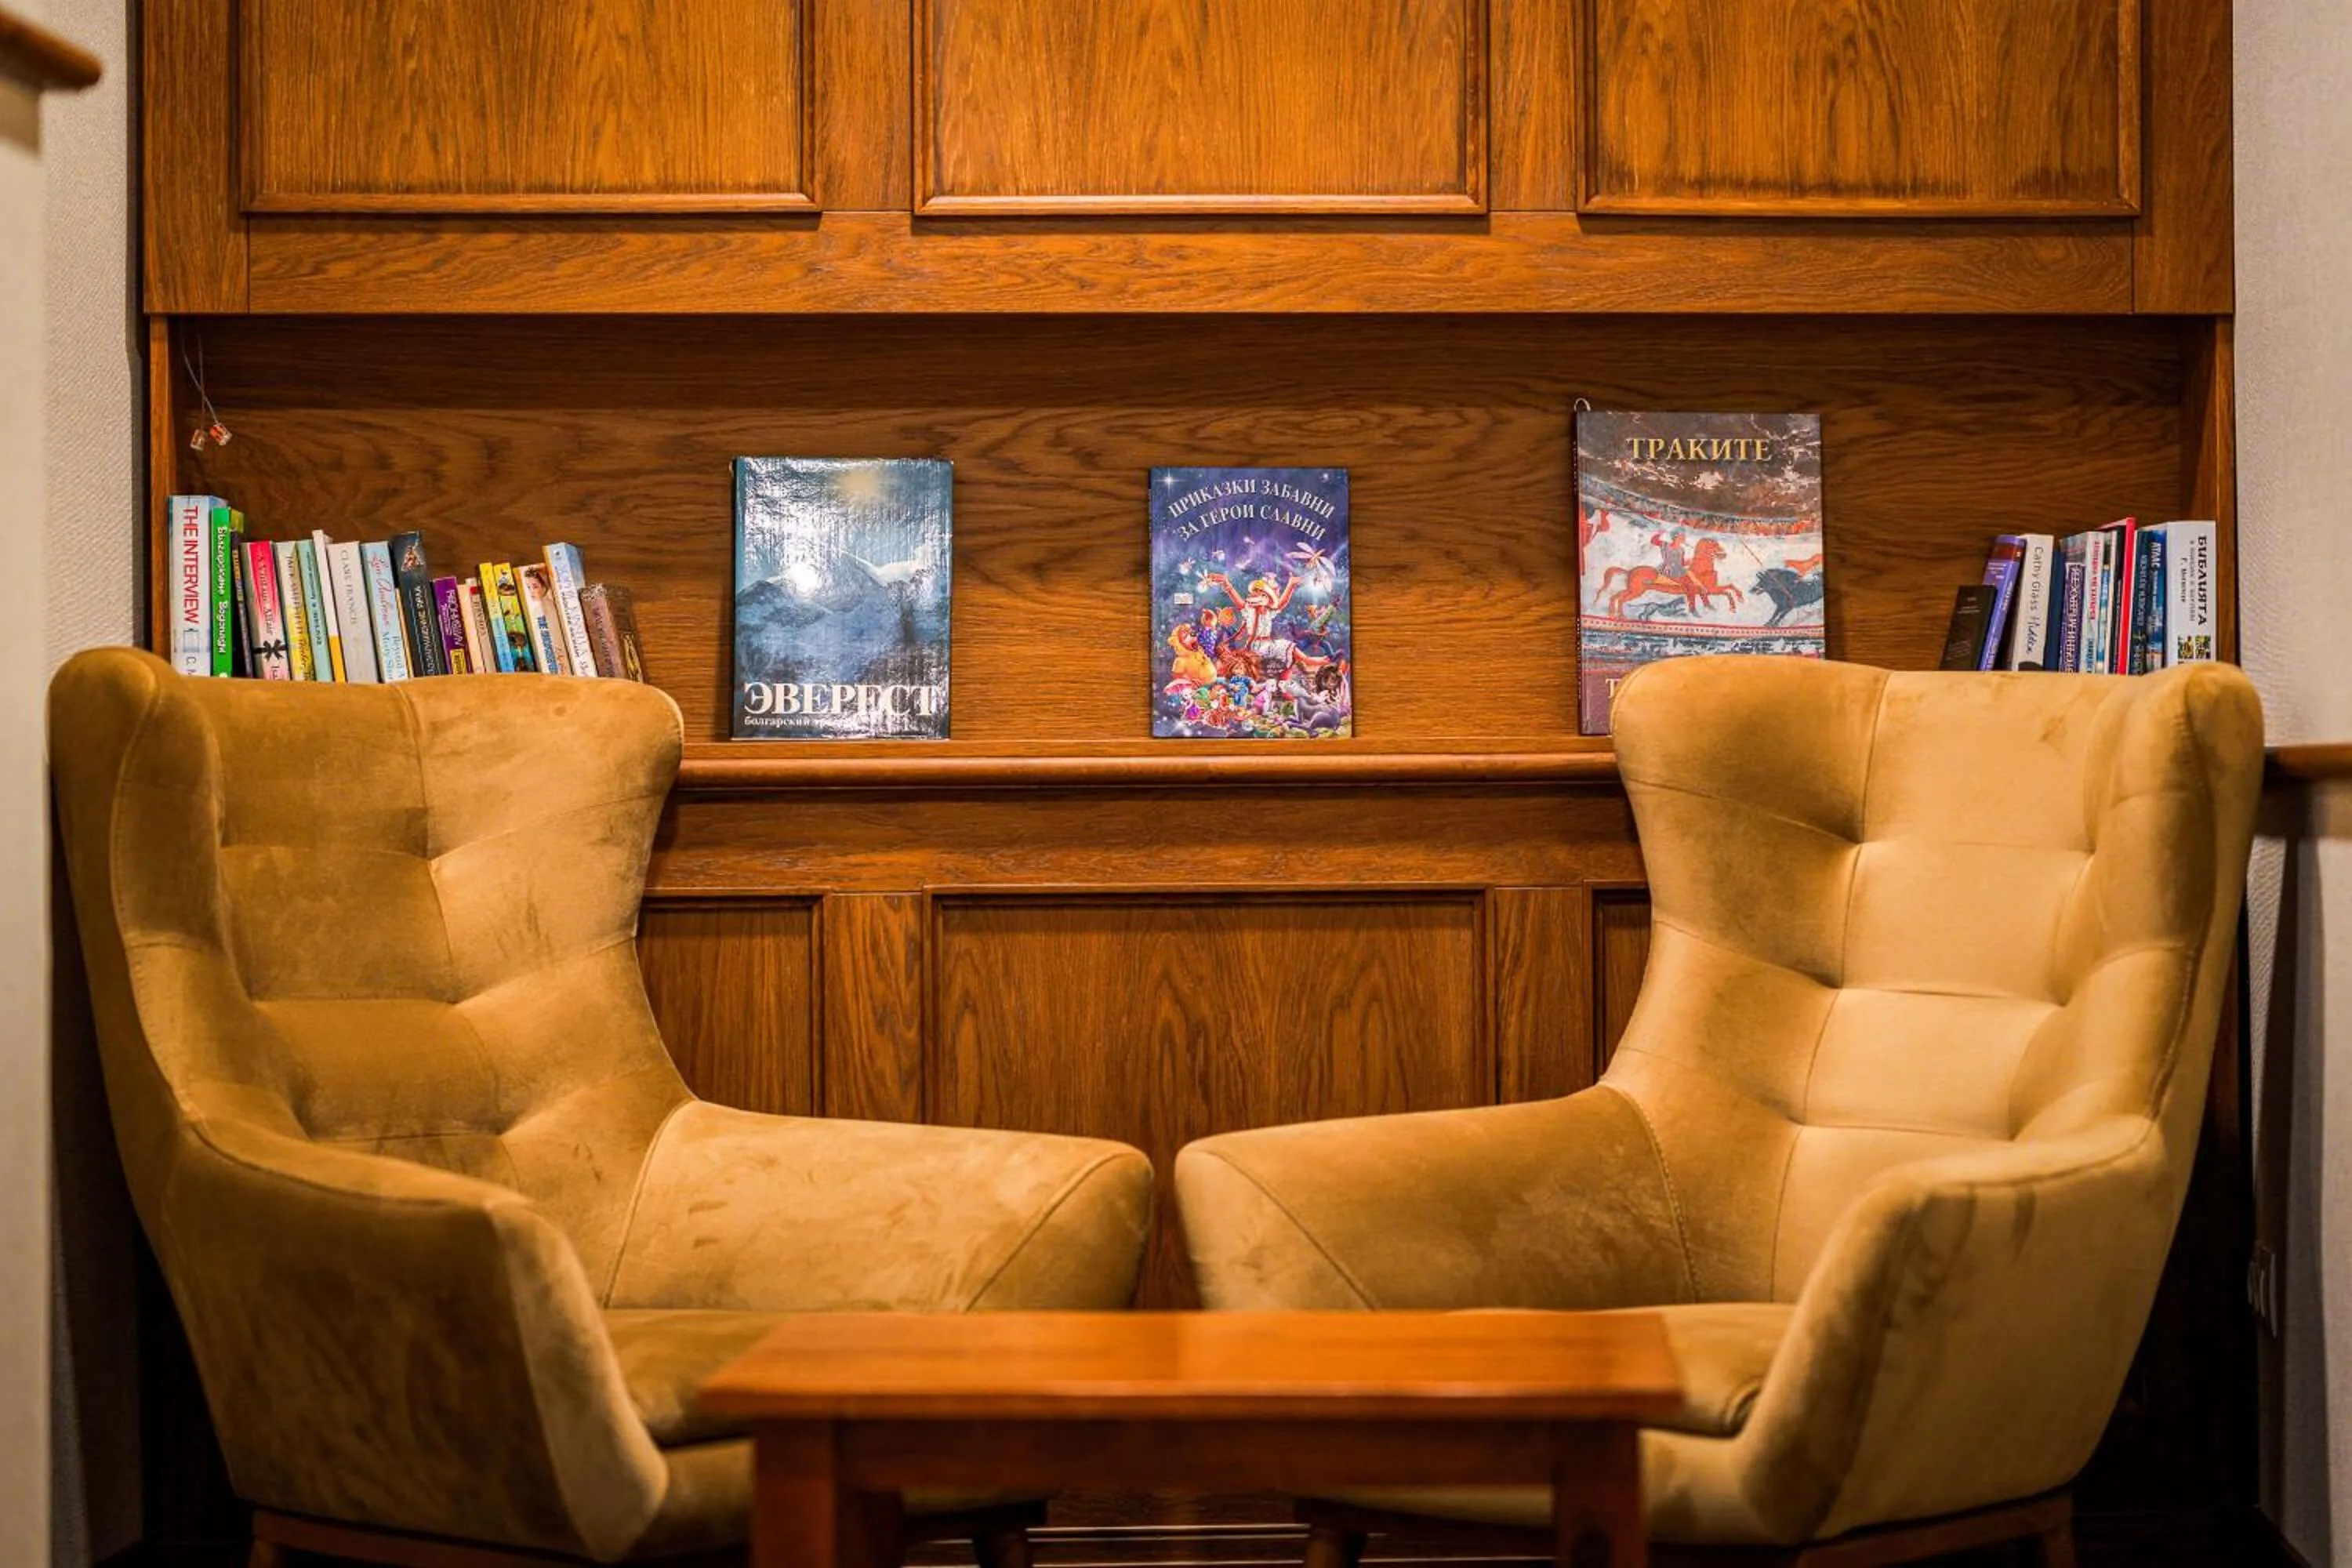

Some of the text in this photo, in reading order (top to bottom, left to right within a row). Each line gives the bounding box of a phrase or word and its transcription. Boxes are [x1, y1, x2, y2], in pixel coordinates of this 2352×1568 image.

[1626, 438, 1773, 462] ТРАКИТЕ
[1167, 479, 1335, 520] ПРИКАЗКИ ЗАБАВНИ
[1178, 505, 1327, 542] ЗА ГЕРОИ СЛАВНИ
[182, 506, 200, 625] THE INTERVIEW
[2029, 546, 2044, 611] Cathy Glass
[2197, 535, 2207, 626] БИБЛИЯТА
[744, 682, 936, 716] ЭВЕРЕСТ
